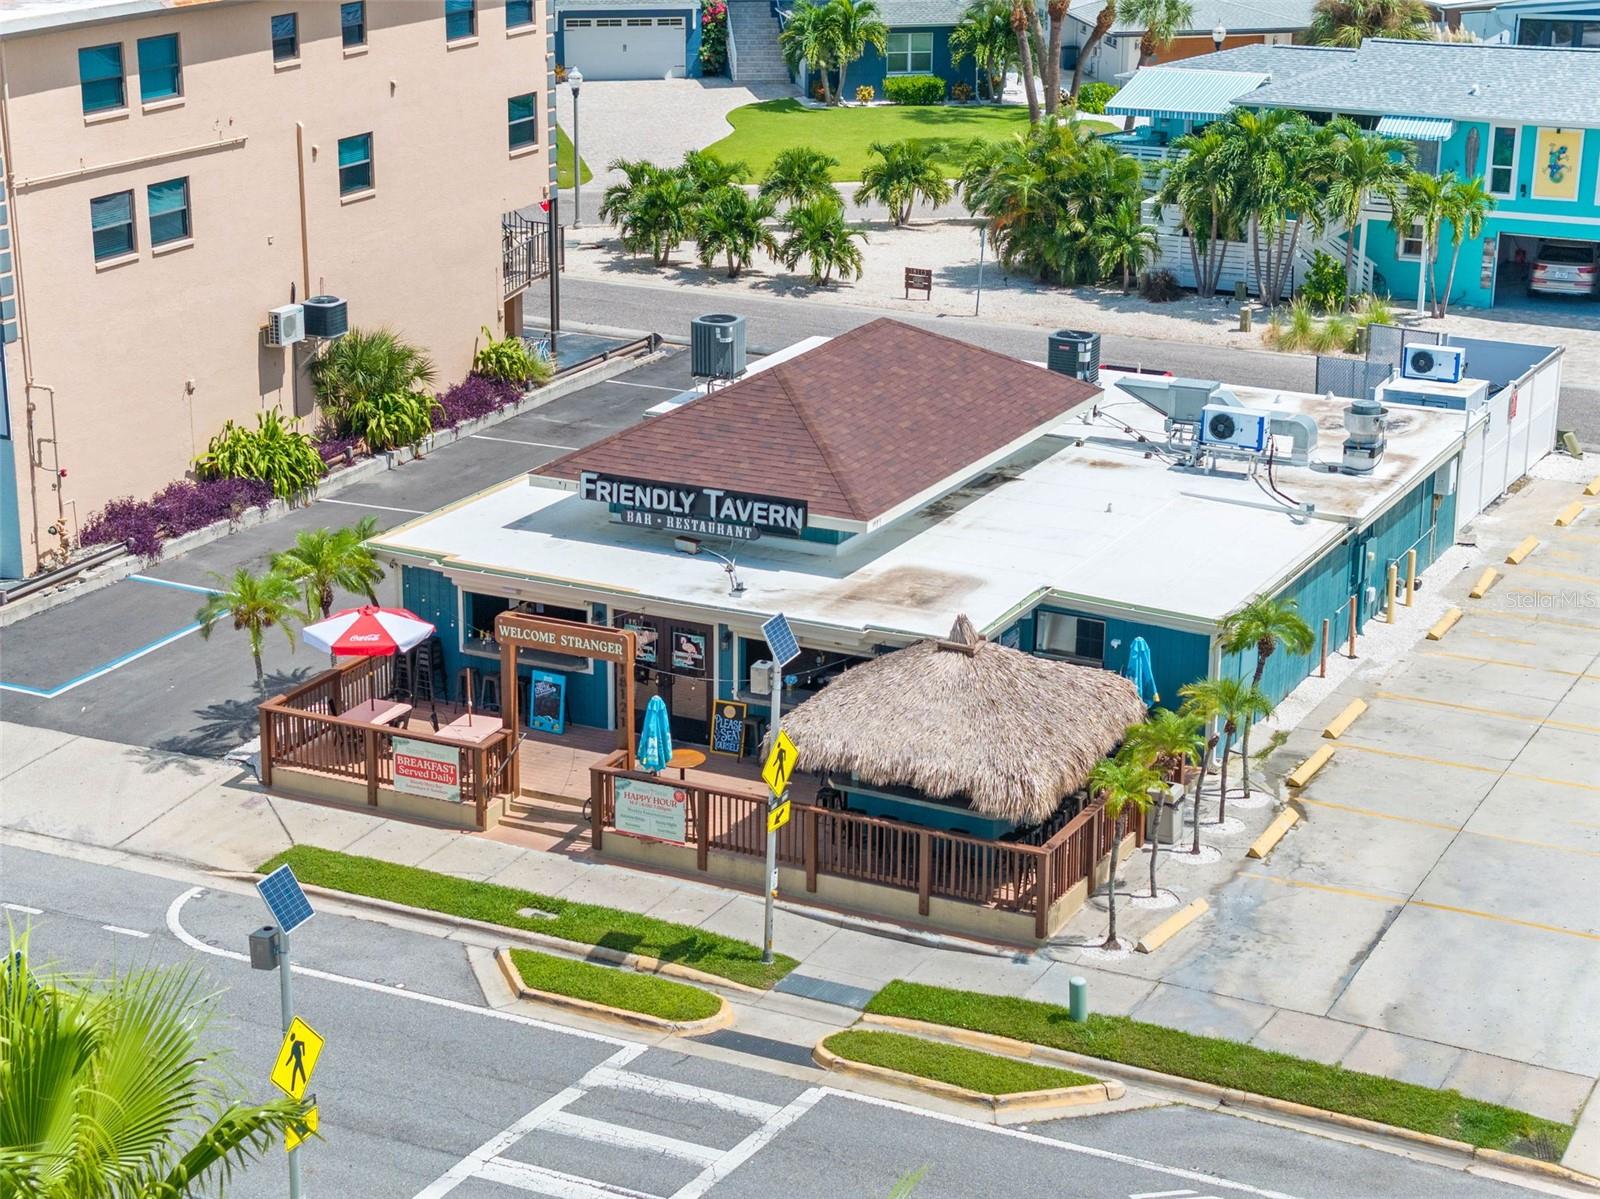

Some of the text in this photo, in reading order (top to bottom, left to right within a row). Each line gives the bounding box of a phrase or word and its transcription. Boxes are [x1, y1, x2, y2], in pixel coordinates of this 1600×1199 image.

[580, 472, 804, 530] FRIENDLY TAVERN
[625, 510, 754, 540] BAR RESTAURANT
[498, 625, 624, 656] WELCOME STRANGER
[714, 713, 743, 732] PLEASE
[397, 755, 456, 774] BREAKFAST
[398, 765, 430, 779] Served
[430, 771, 455, 785] Daily
[623, 791, 652, 804] HAPPY
[653, 797, 678, 809] HOUR
